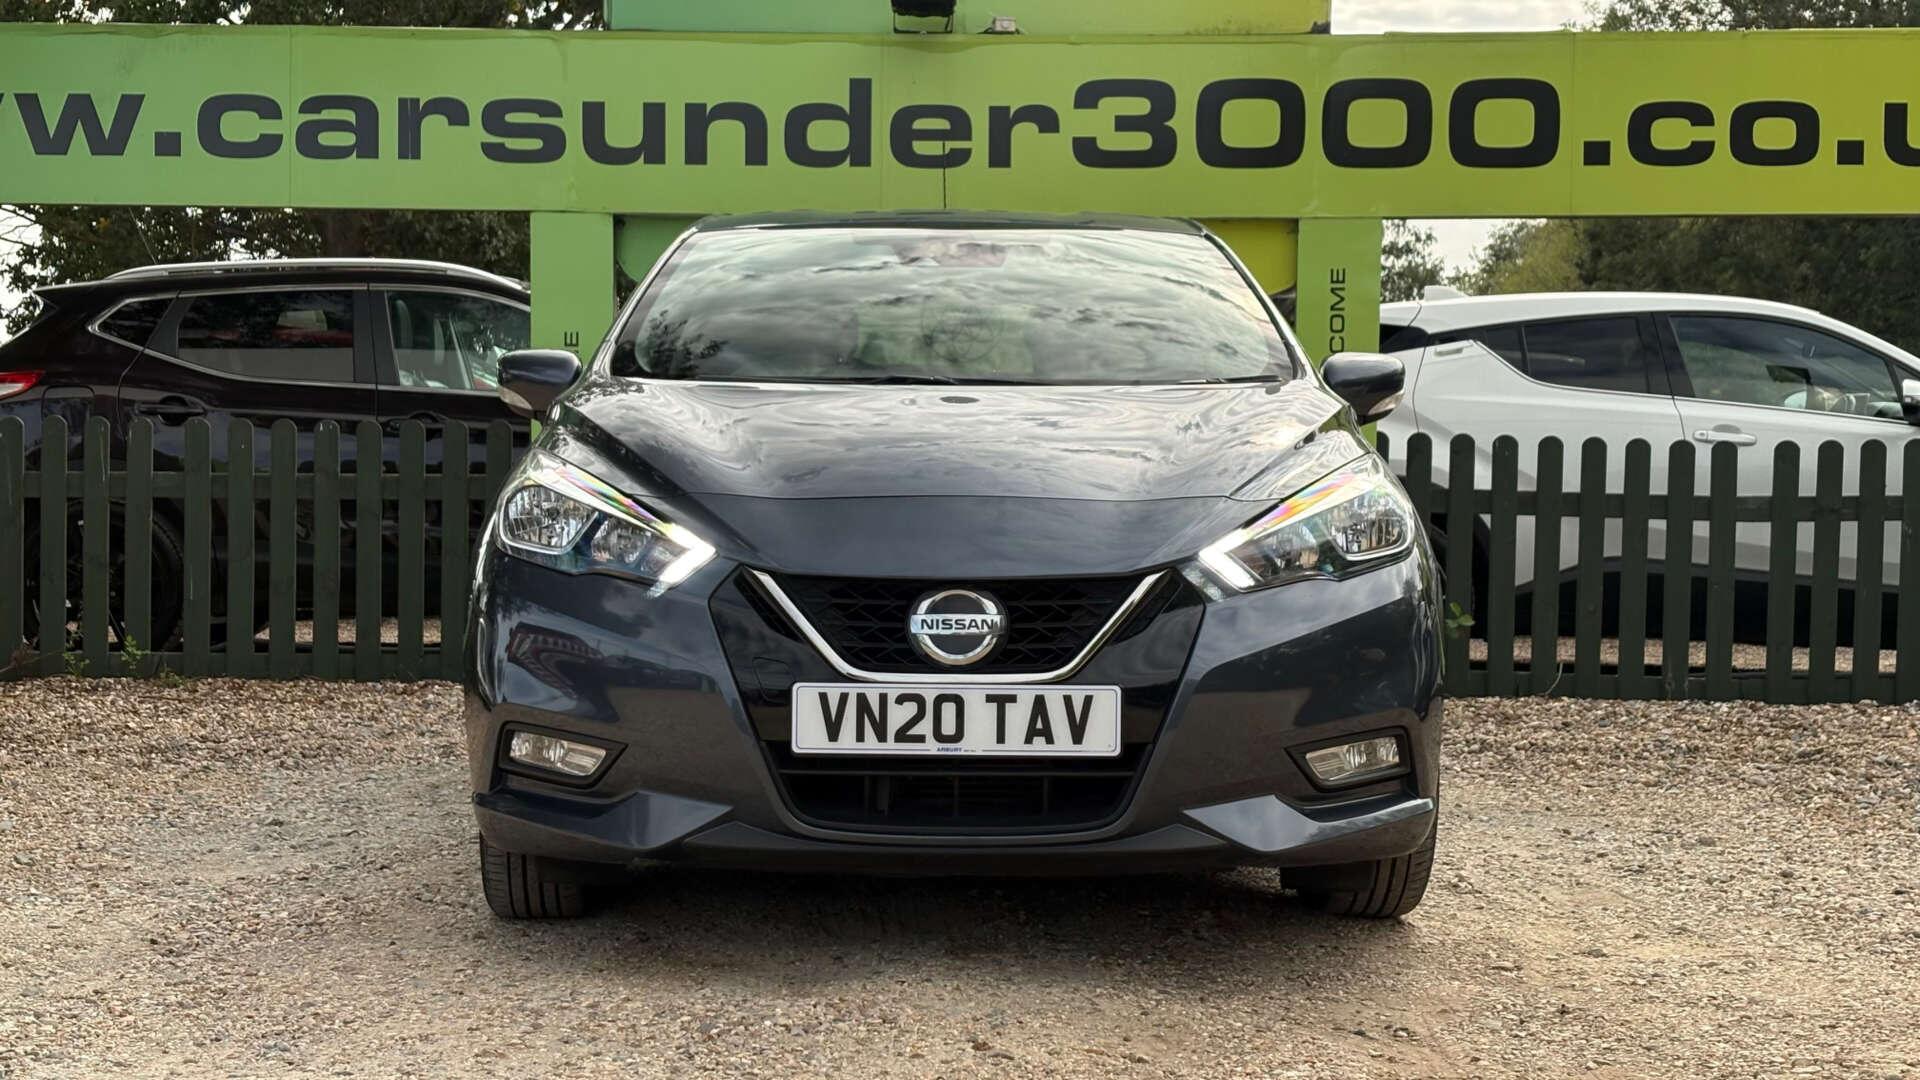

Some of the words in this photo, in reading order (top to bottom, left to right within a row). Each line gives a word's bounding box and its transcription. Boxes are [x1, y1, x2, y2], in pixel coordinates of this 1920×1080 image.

[0, 78, 1920, 169] w.carsunder3000.co.
[920, 618, 994, 630] NISSAN
[818, 692, 965, 744] VN20
[985, 694, 1094, 745] TAV
